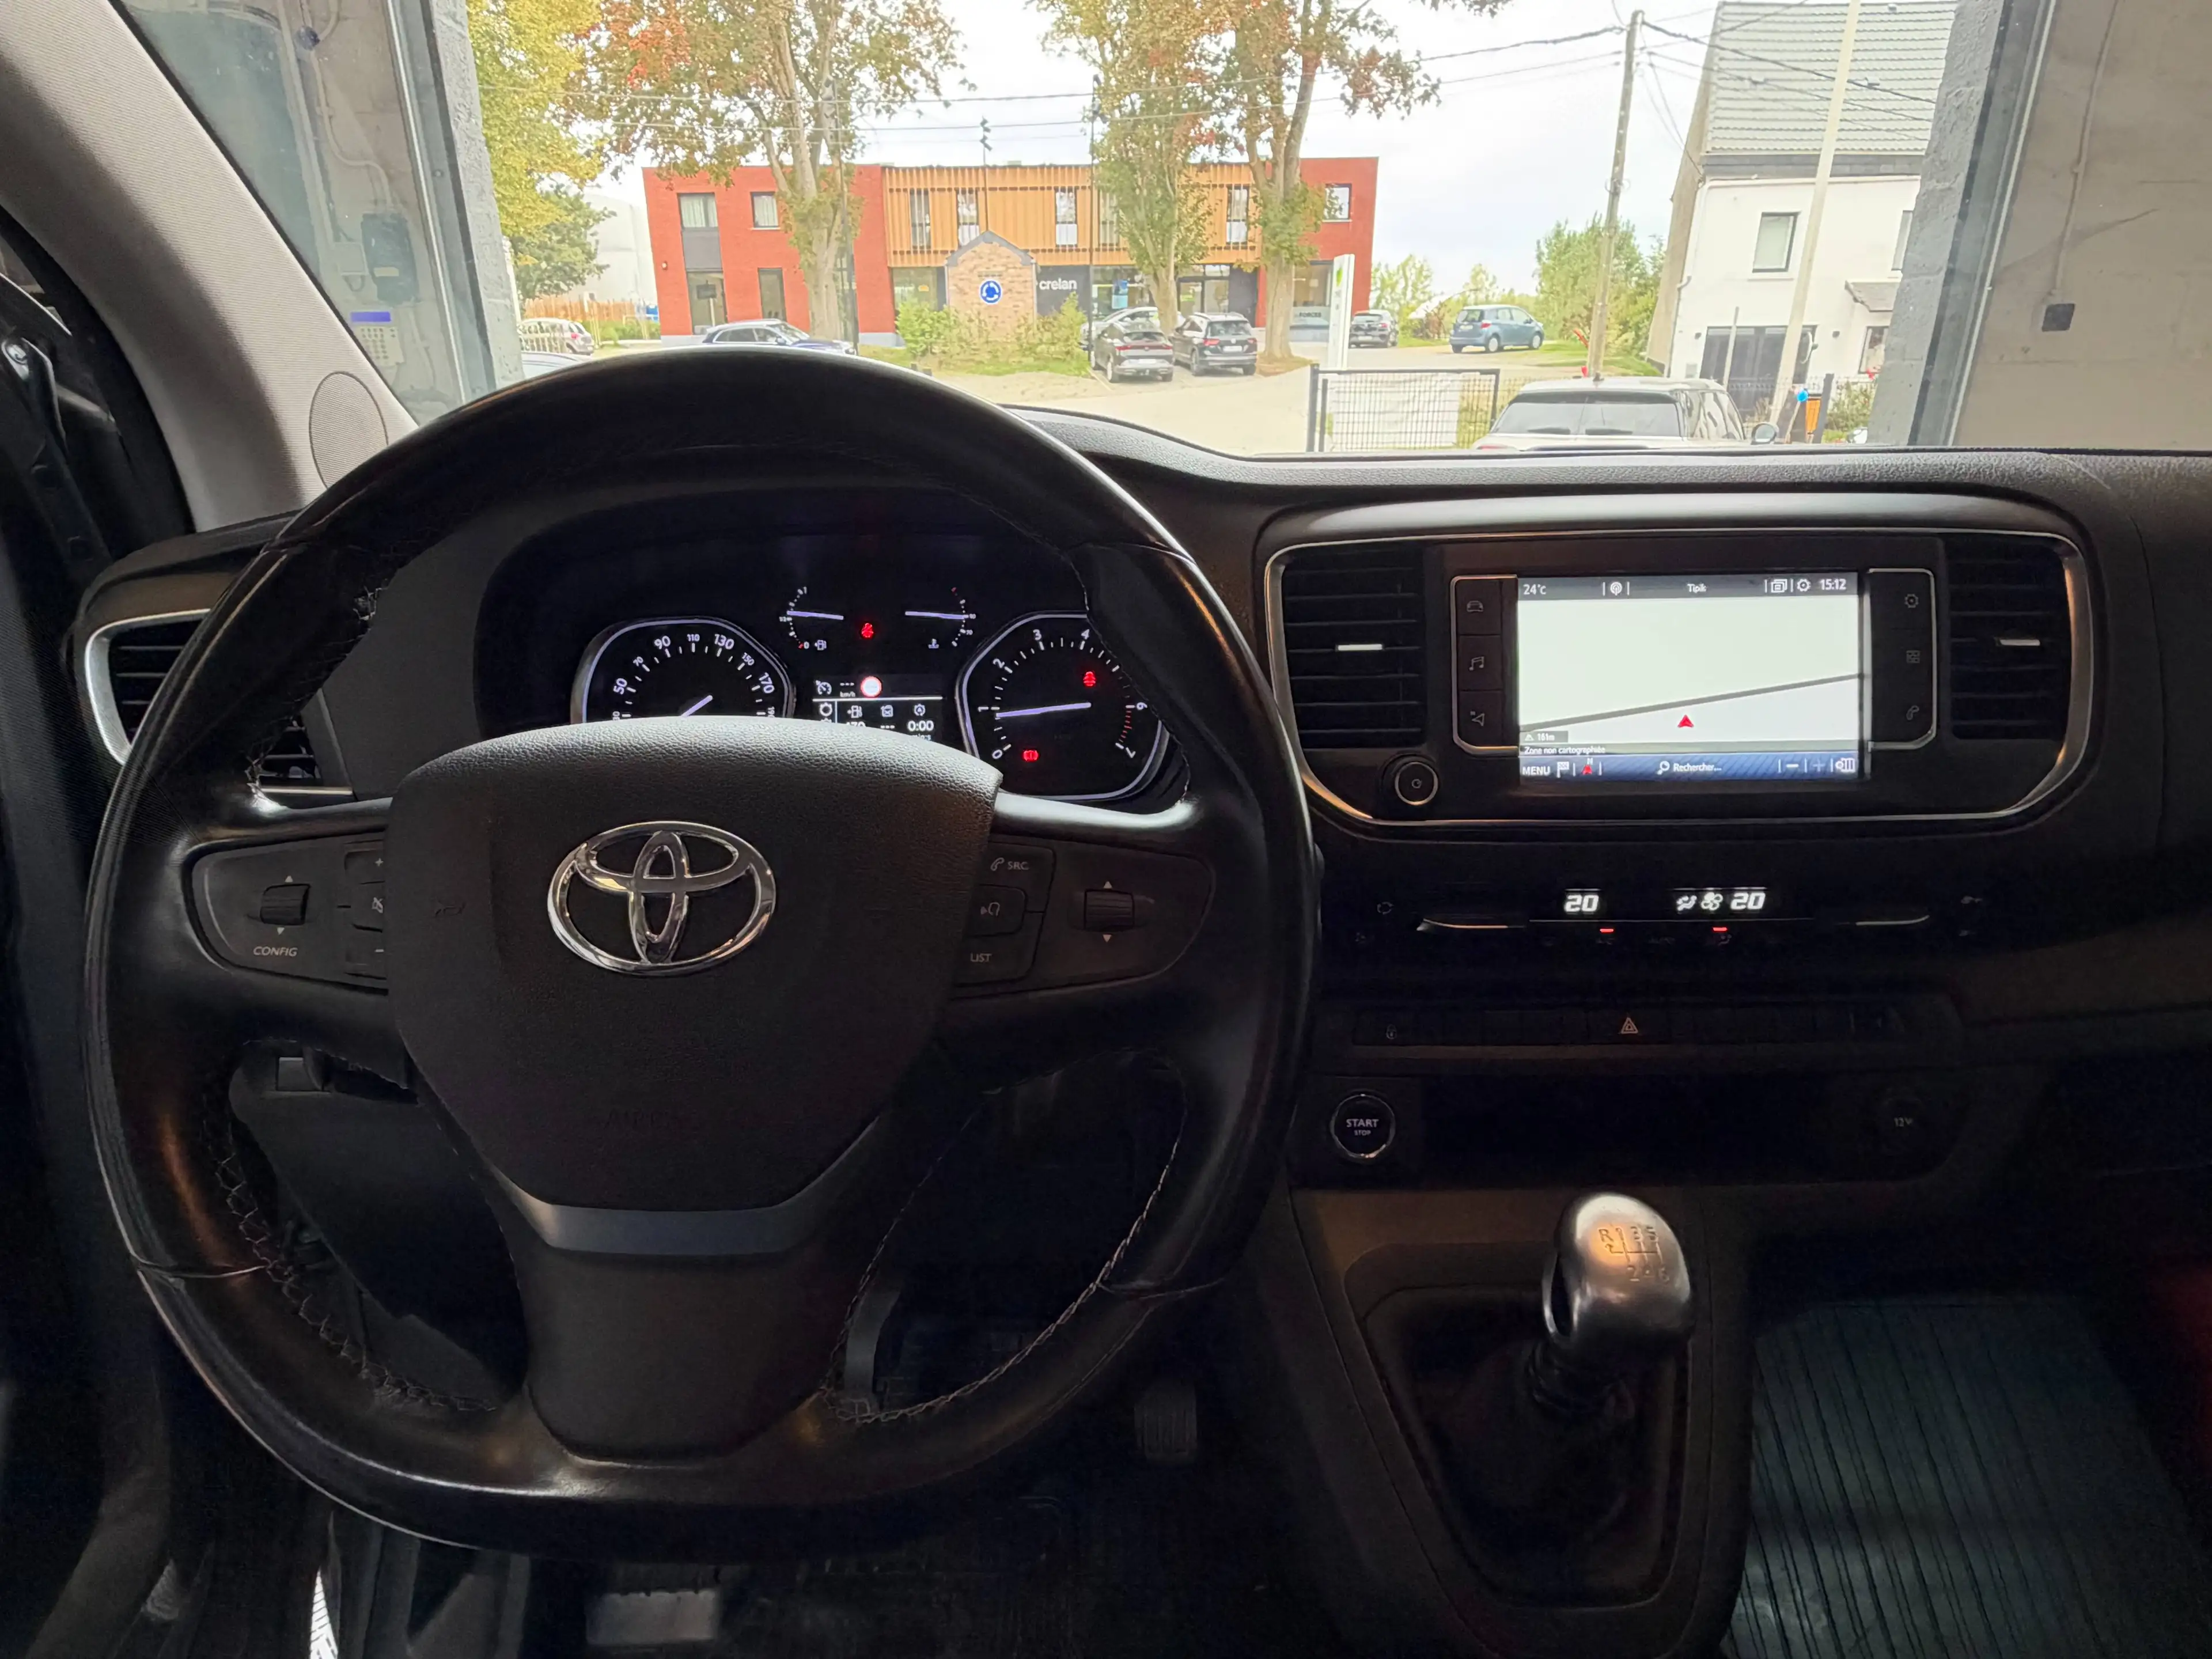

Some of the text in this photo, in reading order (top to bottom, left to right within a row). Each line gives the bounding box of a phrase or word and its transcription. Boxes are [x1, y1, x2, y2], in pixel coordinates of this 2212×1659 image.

[1039, 278, 1077, 290] crelan
[1820, 578, 1847, 590] 15:12
[687, 634, 700, 642] 110
[1033, 629, 1042, 640] 3
[1081, 628, 1090, 639] 4
[654, 635, 671, 650] 90
[714, 634, 734, 650] 130
[632, 656, 643, 666] 70
[742, 652, 755, 666] 150
[993, 658, 1005, 669] 2
[613, 677, 628, 695] 50
[759, 672, 775, 694] 170
[1136, 702, 1148, 711] 6
[907, 720, 934, 732] 0:00
[992, 749, 1003, 759] 0
[1124, 747, 1136, 759] 7
[1524, 747, 1543, 755] Zone
[1522, 766, 1551, 776] MENU
[1007, 861, 1030, 870] SRC
[1564, 894, 1600, 912] 20
[1730, 892, 1766, 910] 20
[252, 945, 298, 957] CONFIG
[970, 953, 993, 963] LIST
[1346, 1118, 1380, 1128] START
[1598, 1228, 1614, 1243] R
